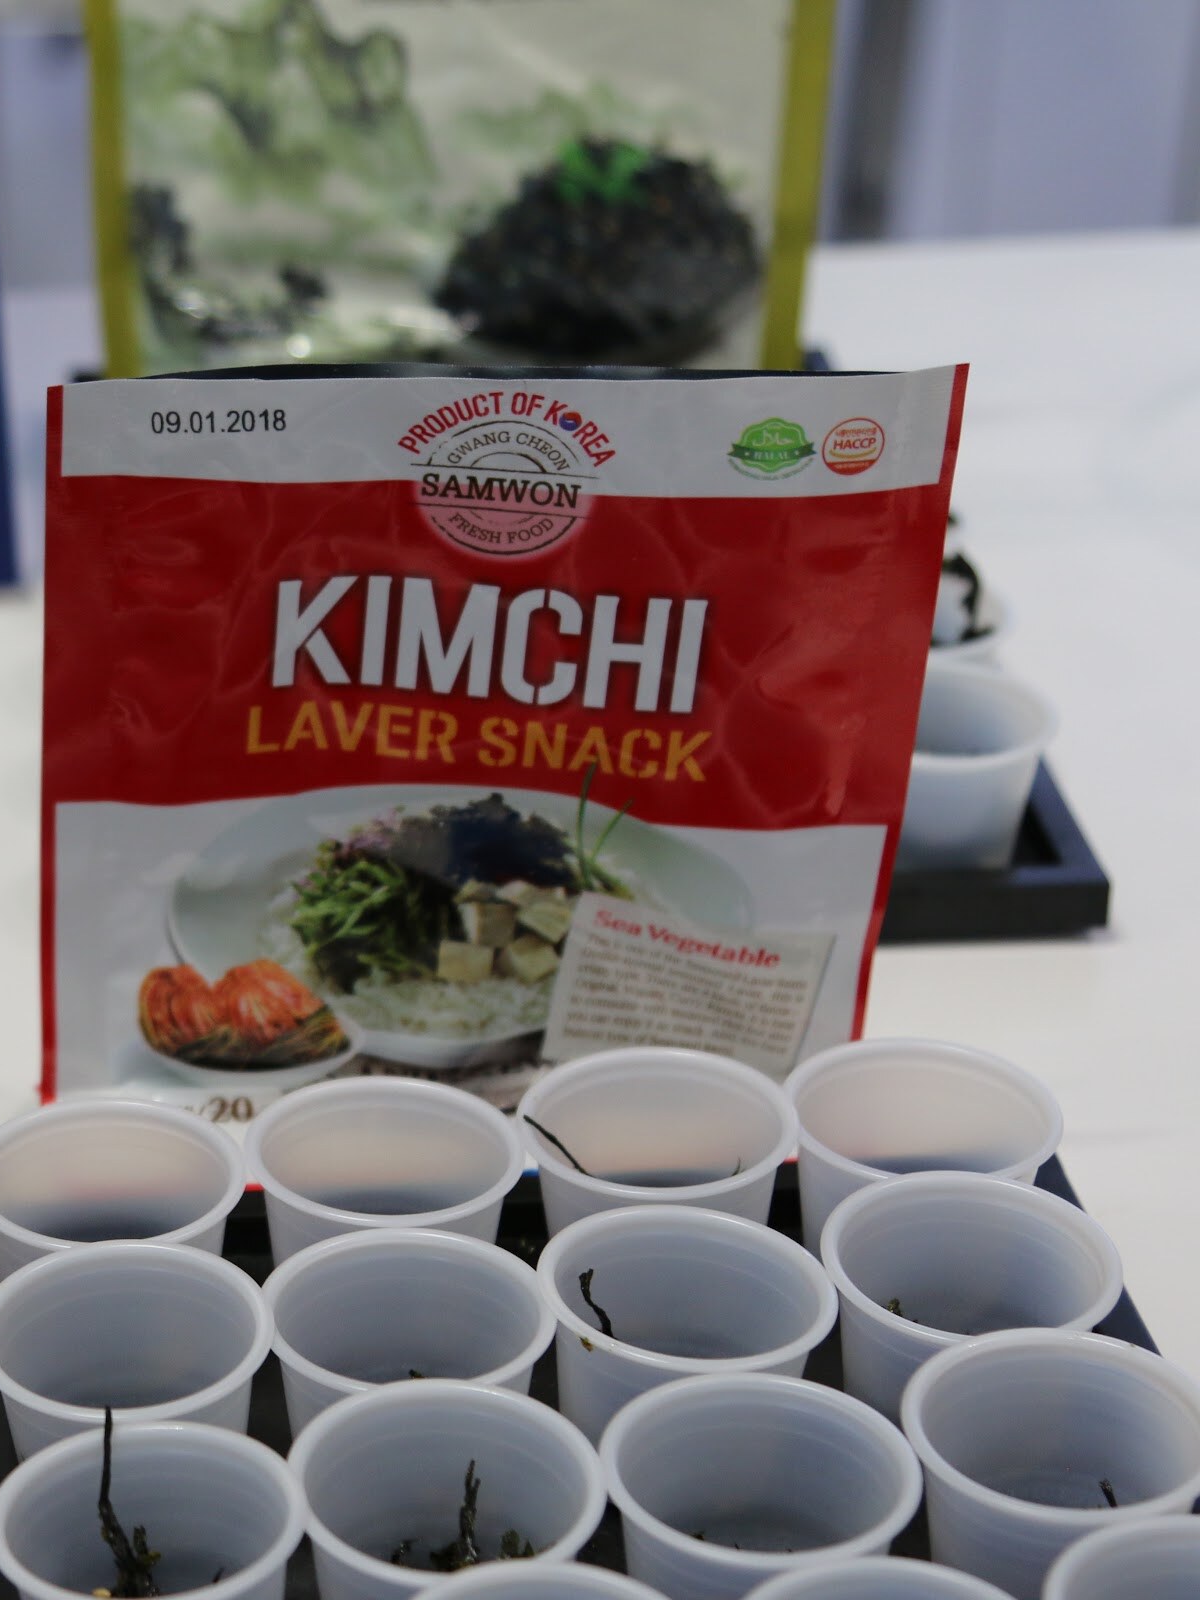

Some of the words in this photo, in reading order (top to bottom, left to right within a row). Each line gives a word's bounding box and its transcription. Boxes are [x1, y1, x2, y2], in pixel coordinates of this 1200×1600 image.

[151, 408, 287, 434] 09.01.2018
[398, 391, 504, 454] PRODUCT
[511, 392, 545, 417] OF
[447, 430, 511, 465] GWANG
[516, 431, 571, 472] CHEON
[833, 437, 877, 450] HACCP
[420, 472, 582, 509] SAMWON
[448, 512, 502, 544] FRESH
[508, 518, 555, 544] FOOD
[272, 575, 708, 714] KIMCHI
[246, 700, 459, 763] LAVER
[477, 716, 713, 782] SNACK
[594, 908, 642, 937] Sea
[648, 923, 781, 969] Vegetable
